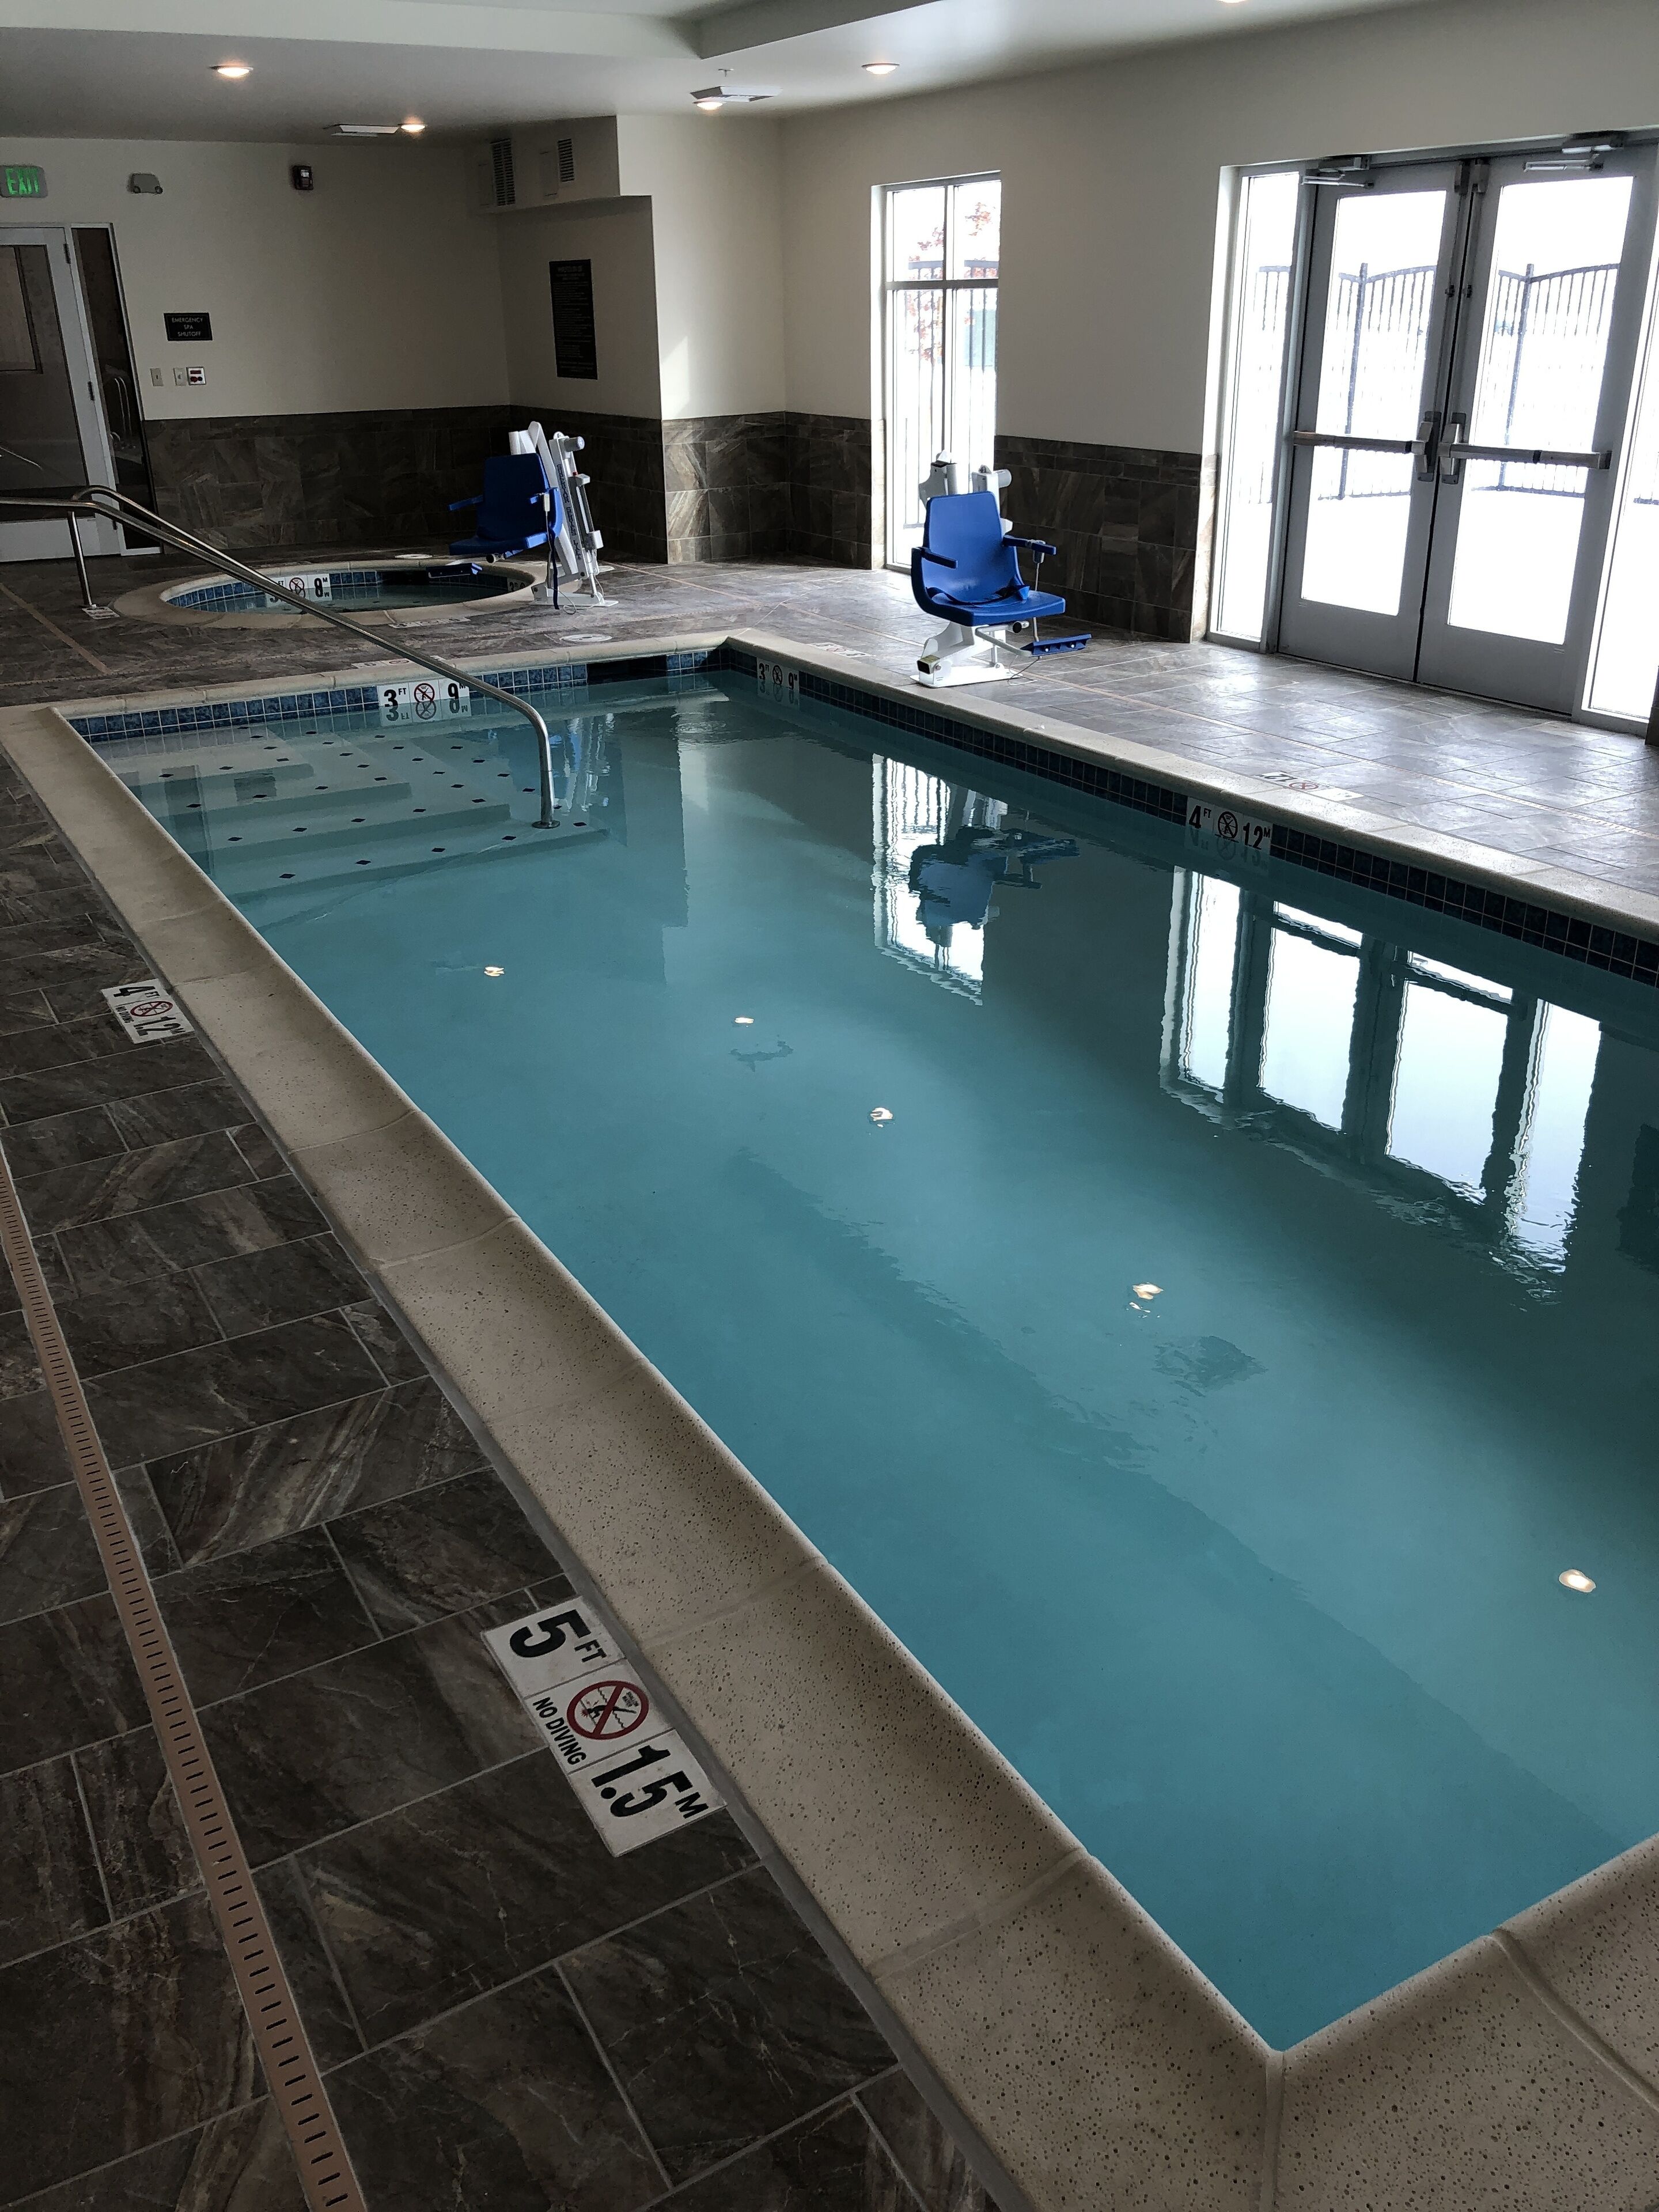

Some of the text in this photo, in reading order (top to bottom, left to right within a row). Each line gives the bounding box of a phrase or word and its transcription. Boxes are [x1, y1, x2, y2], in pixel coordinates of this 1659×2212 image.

[5, 168, 39, 195] EXIT
[759, 663, 766, 680] 3
[788, 672, 794, 690] 9
[384, 689, 399, 707] 3
[448, 683, 459, 700] 9
[1189, 805, 1202, 829] 4
[1203, 808, 1211, 818] FT
[1263, 827, 1271, 838] M
[113, 986, 156, 997] 4
[134, 1016, 181, 1036] 1.2
[509, 1609, 607, 1662] 5 FT
[533, 1697, 586, 1765] NO DIVING
[591, 1745, 709, 1819] 1.5 M
